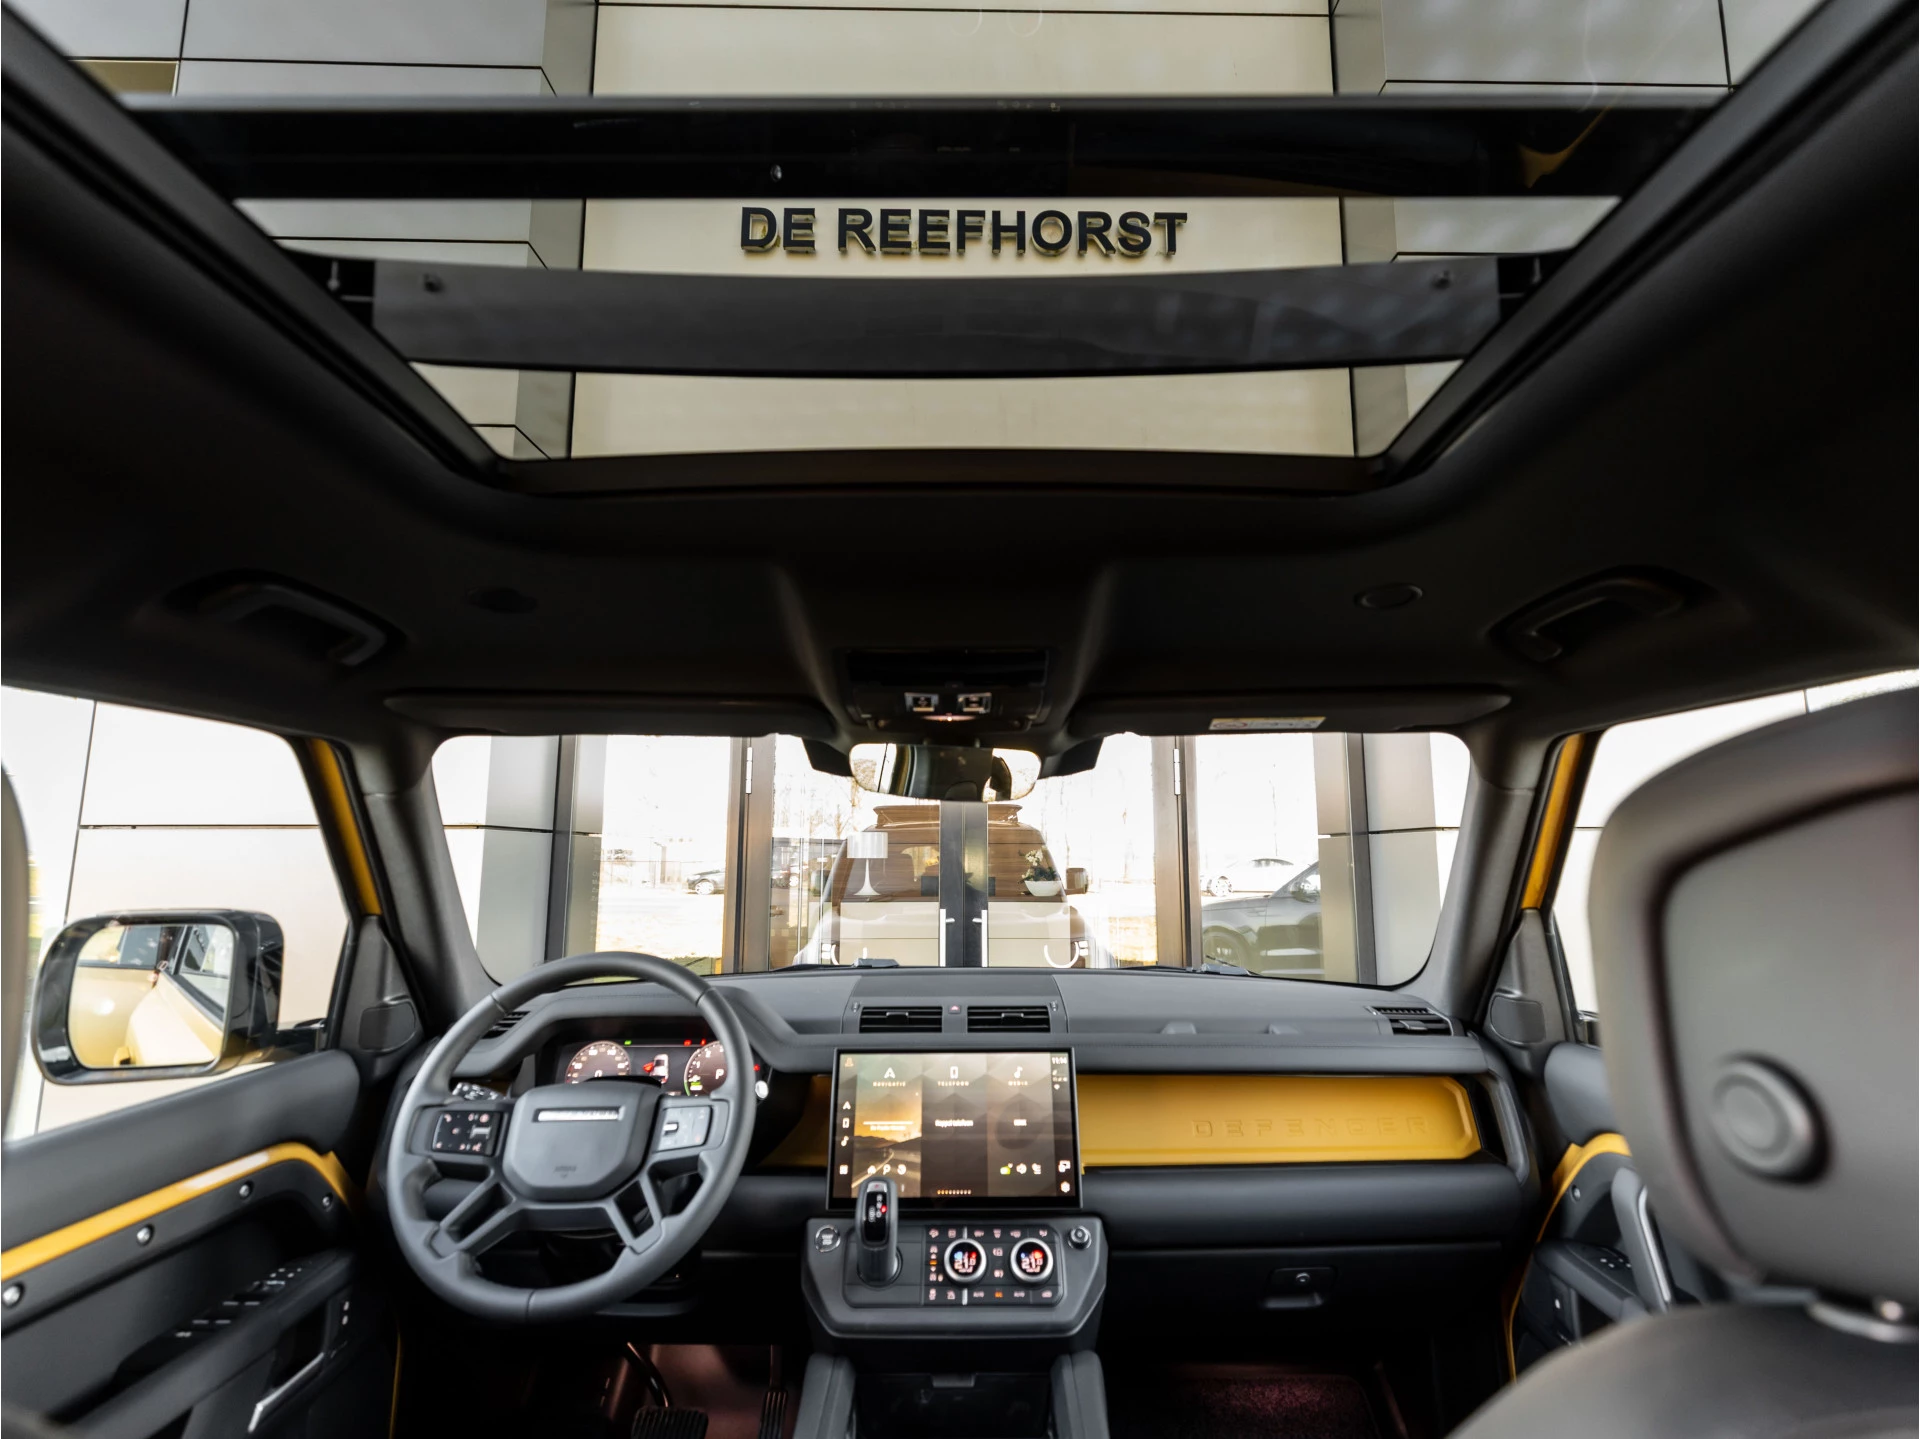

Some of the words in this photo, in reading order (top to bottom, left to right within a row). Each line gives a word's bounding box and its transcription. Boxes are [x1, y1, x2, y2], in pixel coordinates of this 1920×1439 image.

[741, 206, 816, 254] DE
[837, 208, 1188, 256] REEFHORST
[715, 1068, 725, 1079] P
[1191, 1116, 1429, 1139] DEFENDER
